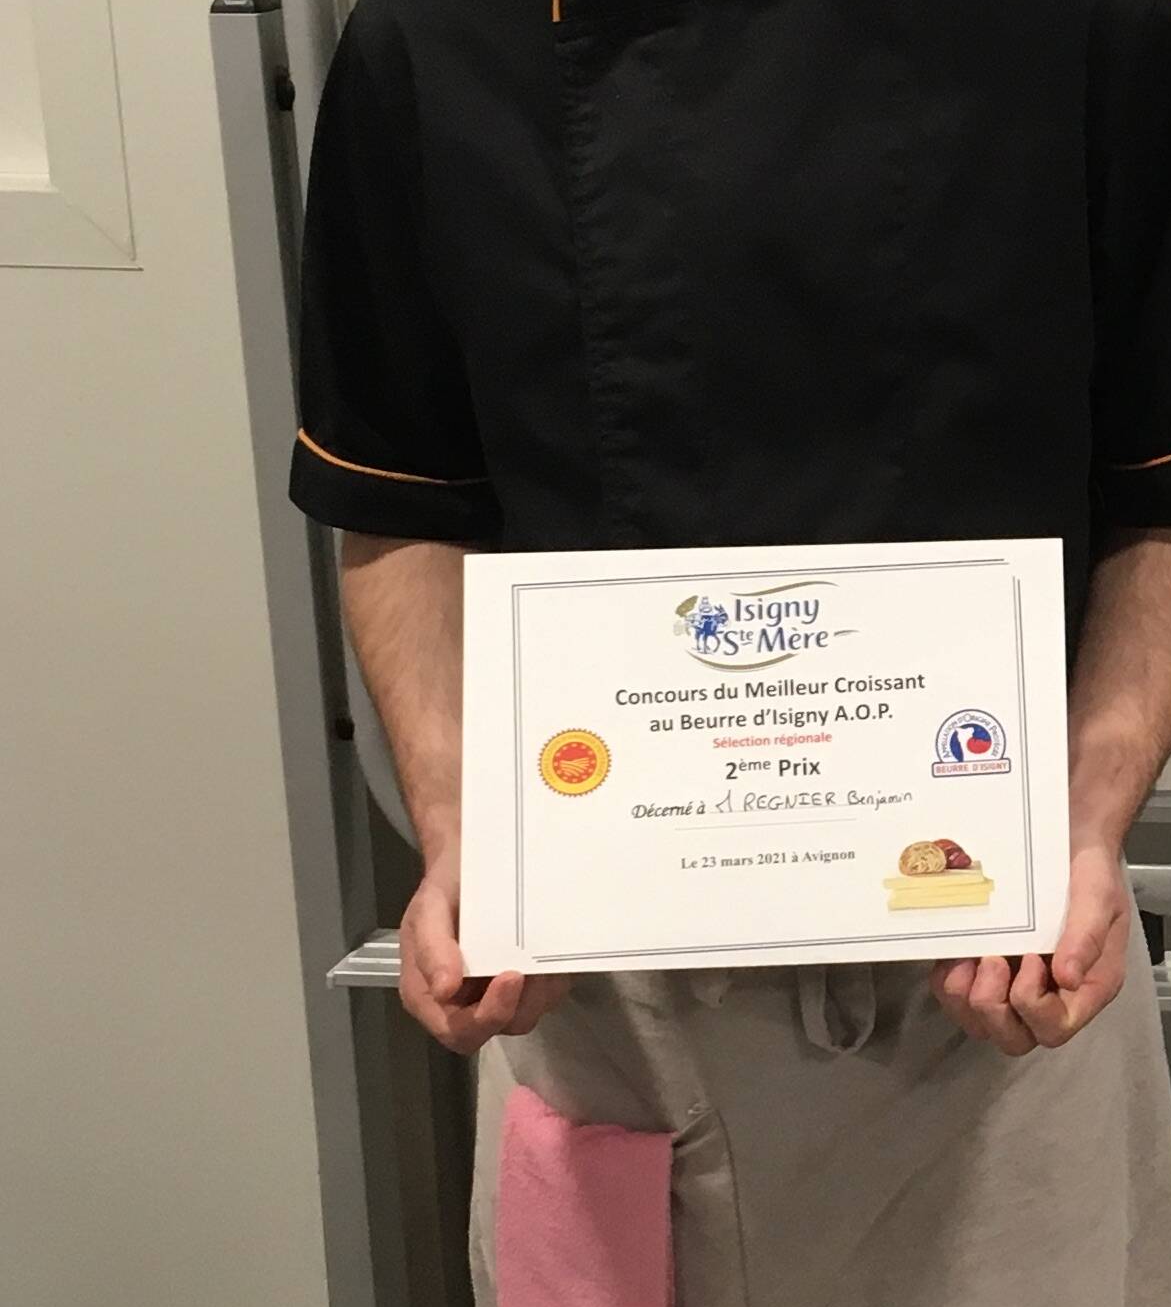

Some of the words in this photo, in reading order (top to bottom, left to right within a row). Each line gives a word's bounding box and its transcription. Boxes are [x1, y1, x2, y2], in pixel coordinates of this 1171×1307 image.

[735, 598, 820, 627] Isigny
[757, 626, 829, 653] Mère
[615, 686, 708, 706] Concours
[713, 682, 739, 700] du
[745, 679, 829, 699] Meilleur
[834, 673, 926, 693] Croissant
[649, 716, 674, 732] au
[680, 712, 747, 730] Beurre
[753, 705, 829, 728] d'Isigny
[834, 703, 894, 722] A.O.P.
[712, 733, 771, 749] Sélection
[773, 731, 833, 747] régionale
[725, 758, 772, 780] 2ème
[778, 757, 821, 777] Prix
[631, 802, 694, 819] Décerné
[695, 800, 707, 815] à
[743, 791, 837, 813] REGNIER
[846, 789, 914, 812] Benjamin
[680, 857, 698, 870] Le
[701, 856, 718, 869] 23
[720, 855, 755, 868] mars
[757, 852, 787, 866] 2021
[791, 850, 800, 863] à
[802, 849, 857, 865] Avignon
